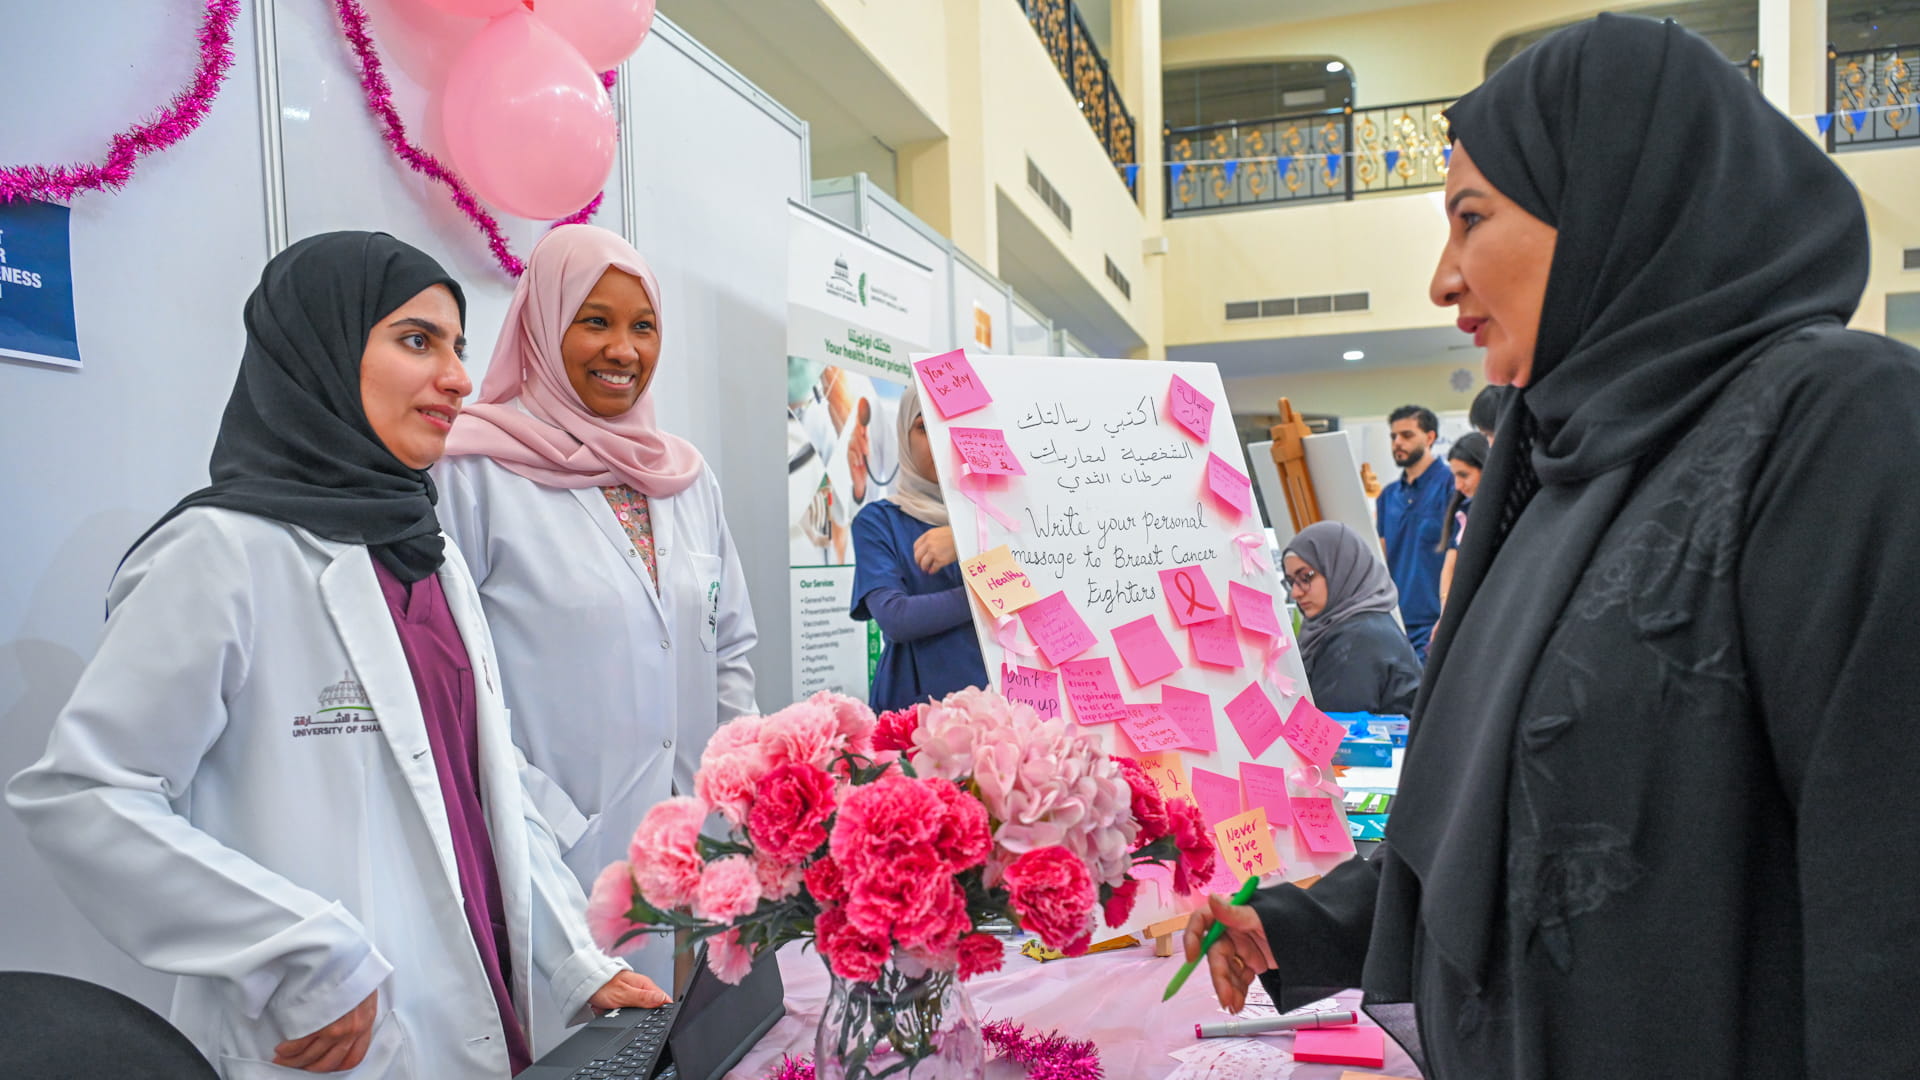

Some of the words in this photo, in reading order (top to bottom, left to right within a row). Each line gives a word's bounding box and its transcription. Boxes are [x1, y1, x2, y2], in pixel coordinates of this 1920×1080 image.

[824, 337, 842, 356] Your
[843, 344, 866, 363] health
[866, 352, 873, 365] is
[874, 356, 887, 369] our
[887, 358, 912, 379] priority
[923, 362, 955, 383] You'll
[936, 385, 952, 396] be
[1017, 401, 1091, 432] رسالتك
[1103, 395, 1158, 438] اكتبي
[1121, 441, 1194, 466] الشخصية
[1057, 471, 1111, 493] الثدي
[1120, 468, 1172, 487] سرطان
[1025, 504, 1090, 538] Write
[1097, 515, 1136, 550] your
[967, 561, 987, 577] Eat
[1011, 549, 1076, 579] message
[1083, 545, 1101, 568] to
[1113, 545, 1164, 568] Breast
[1171, 545, 1218, 565] Cancer
[987, 570, 1031, 590] Healthy
[1038, 698, 1058, 718] up
[292, 726, 343, 738] UNIVERSITY
[346, 725, 358, 734] OF
[1226, 818, 1257, 842] Never
[1234, 839, 1259, 864] give
[1242, 859, 1254, 876] up
